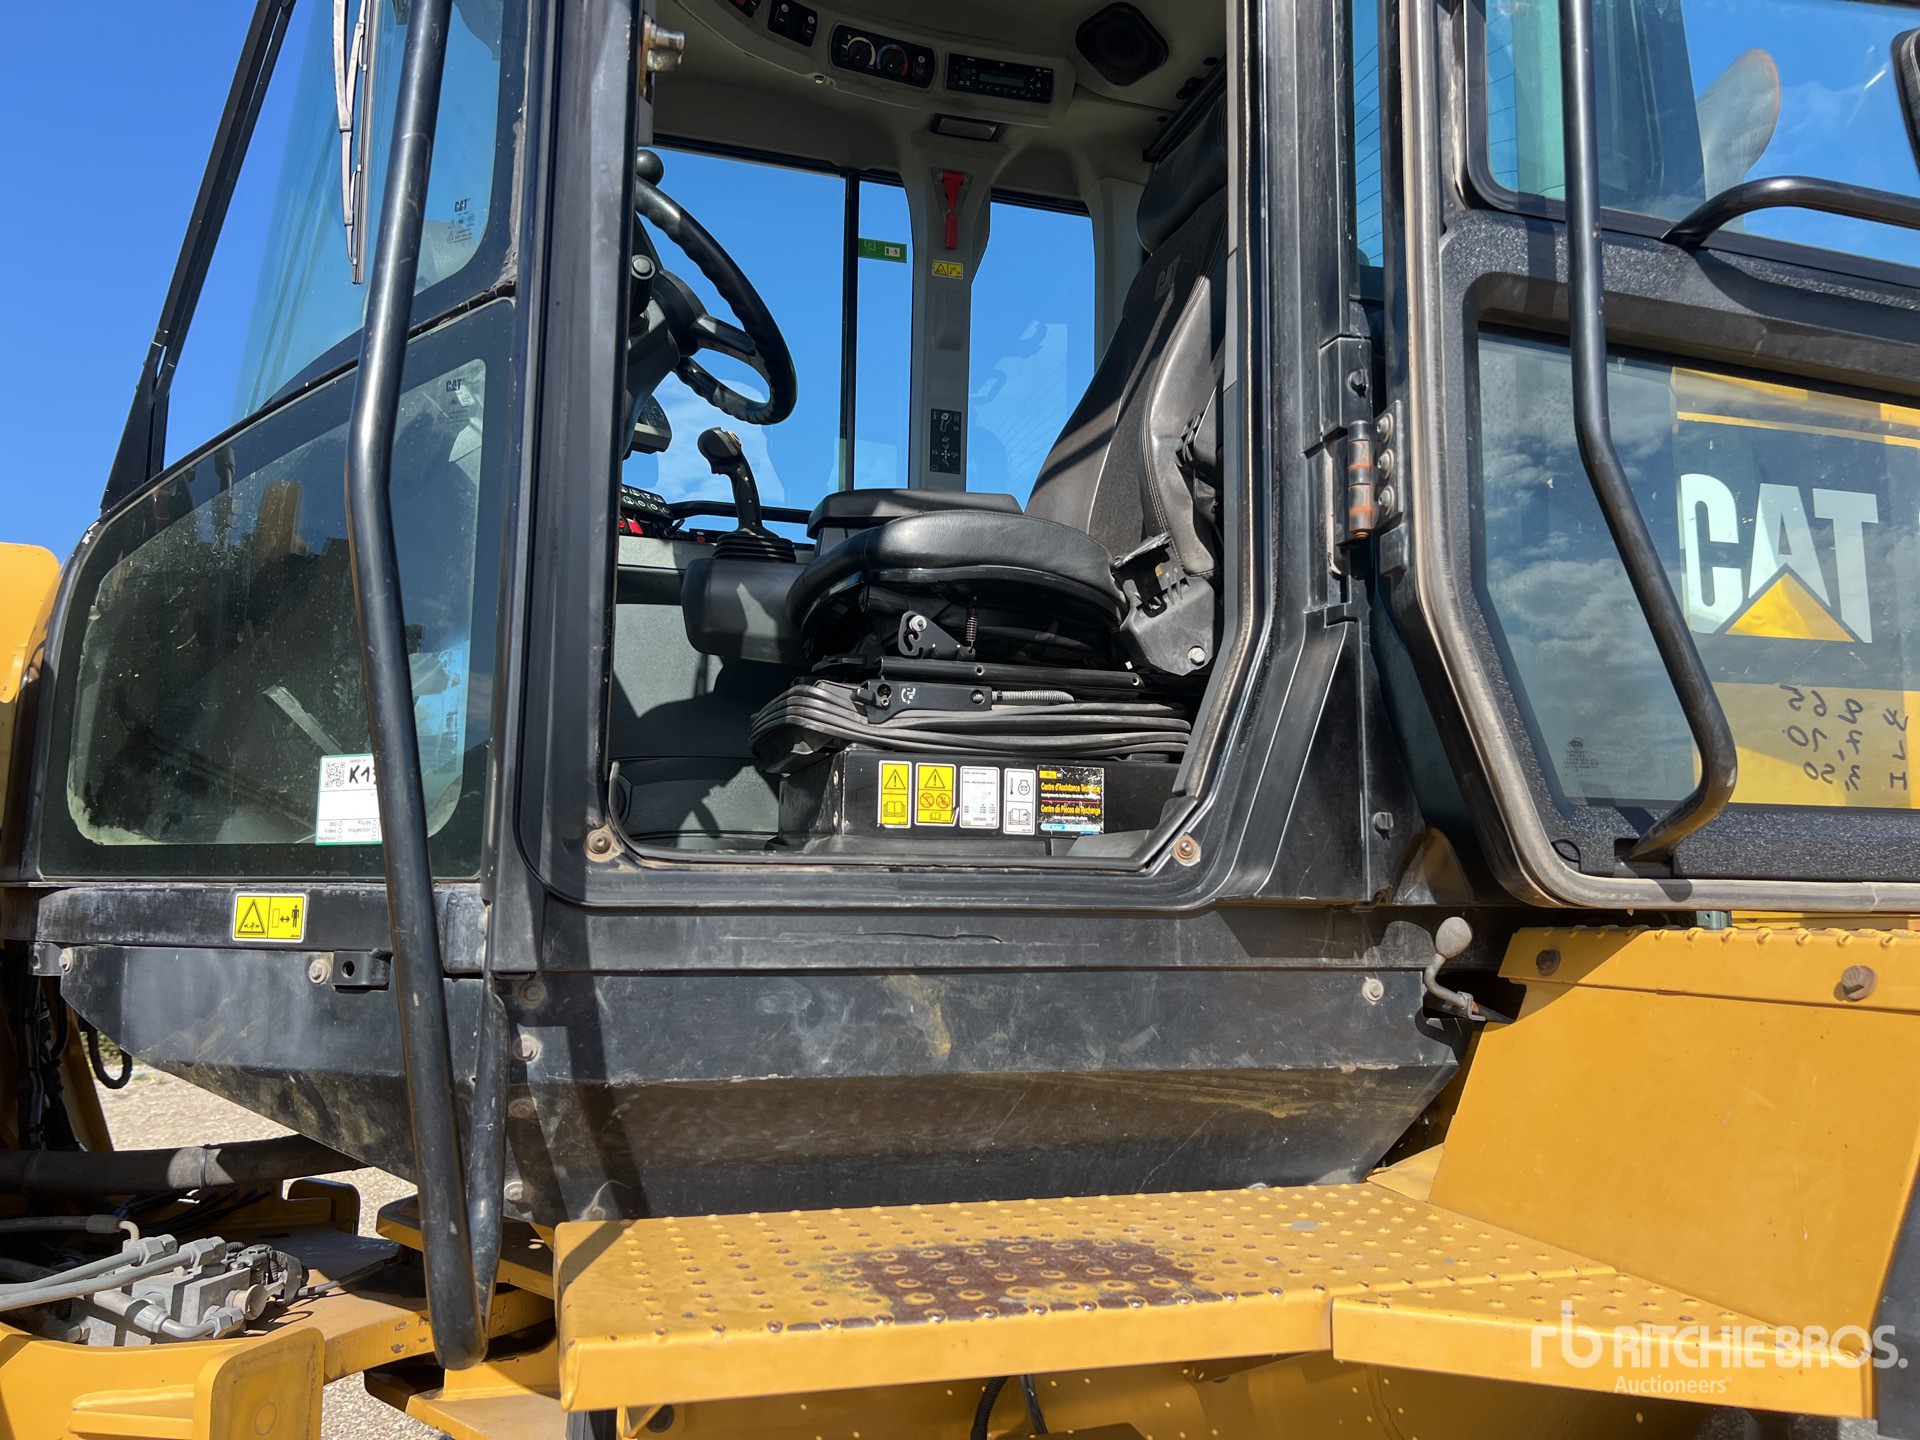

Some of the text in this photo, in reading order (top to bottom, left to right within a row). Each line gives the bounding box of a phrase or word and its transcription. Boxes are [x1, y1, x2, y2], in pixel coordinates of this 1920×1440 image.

[446, 379, 462, 392] CAT
[1680, 473, 1879, 644] CAT
[349, 764, 377, 785] K1
[1041, 782, 1054, 790] Centre
[1041, 804, 1054, 813] Centre
[1080, 806, 1101, 816] Rechange
